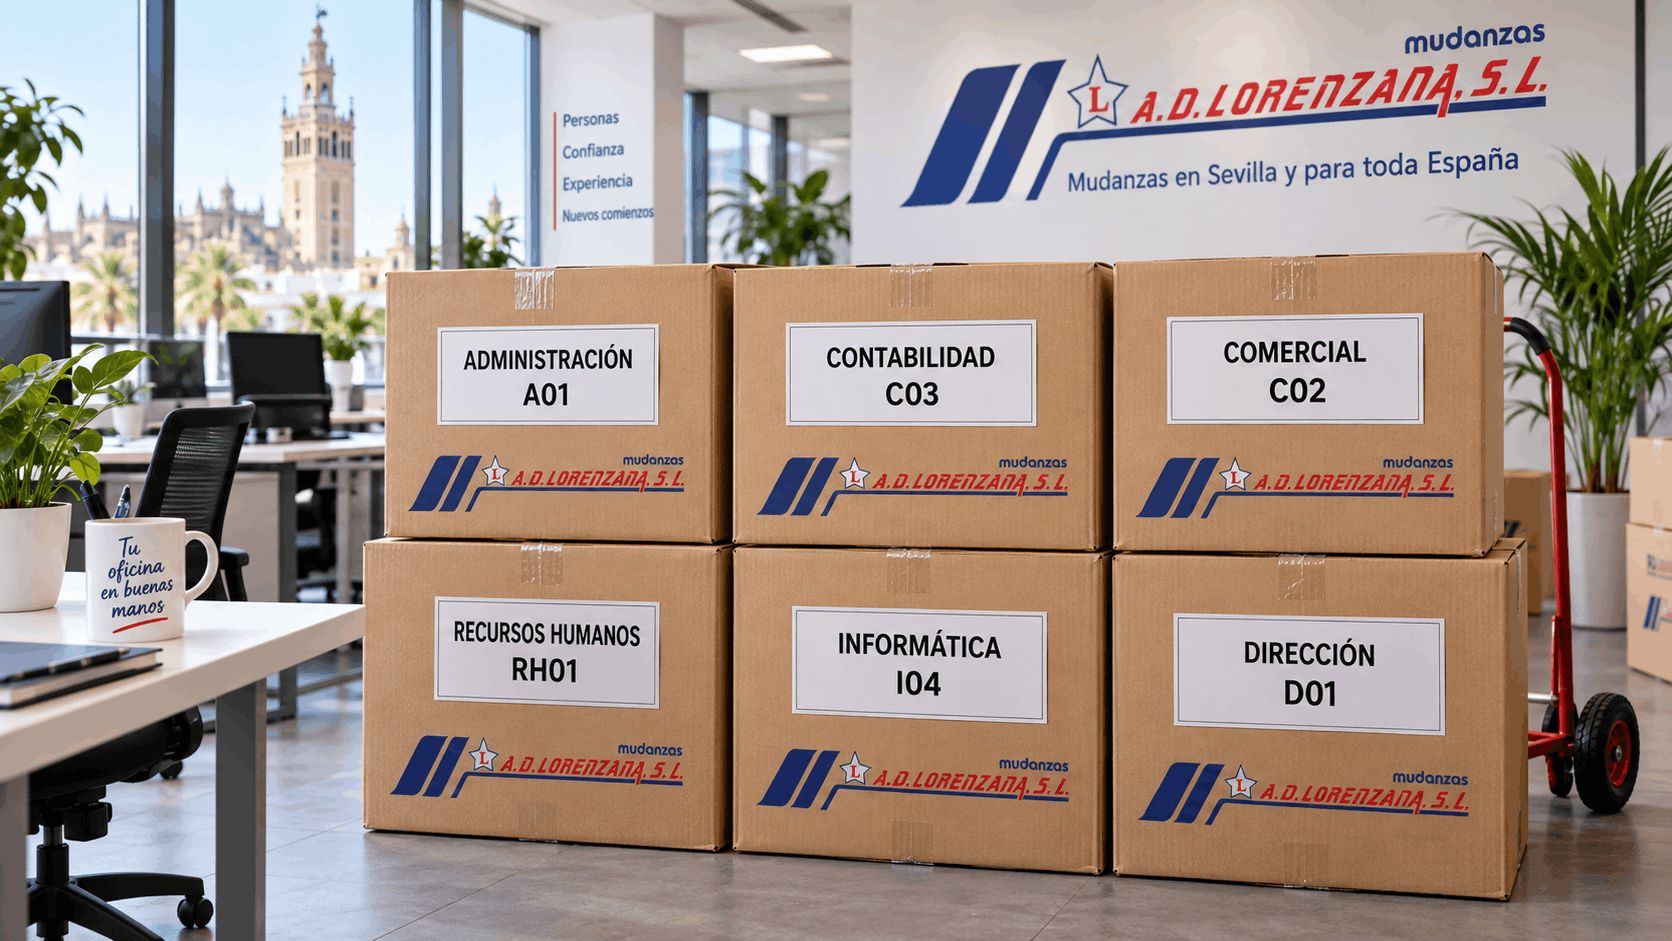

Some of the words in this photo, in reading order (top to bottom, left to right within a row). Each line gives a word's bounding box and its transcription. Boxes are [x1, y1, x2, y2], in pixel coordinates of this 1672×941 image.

[1404, 23, 1546, 55] mudanzas
[1088, 86, 1109, 113] L
[563, 113, 619, 127] Personas
[563, 143, 624, 159] Confianza
[1068, 171, 1168, 193] Mudanzas
[1175, 172, 1200, 187] en
[1208, 161, 1277, 185] Sevilla
[1285, 166, 1298, 187] y
[1305, 162, 1355, 186] para
[1362, 153, 1418, 177] toda
[1428, 147, 1519, 179] España
[563, 173, 633, 194] Experiencia
[562, 209, 599, 222] Nuevos
[601, 206, 654, 220] comienzos
[463, 343, 633, 370] ADMINISTRACIÓN
[826, 346, 995, 369] CONTABILIDAD
[1223, 340, 1367, 364] COMERCIAL
[522, 382, 568, 406] A01
[885, 381, 939, 406] C03
[1269, 377, 1326, 403] C02
[623, 454, 684, 466] mudanzas
[999, 456, 1068, 469] mudanzas
[1383, 456, 1454, 469] mudanzas
[492, 468, 501, 480] L
[850, 470, 861, 483] L
[1230, 471, 1242, 485] L
[118, 536, 141, 558] Tu
[108, 559, 165, 584] oficina
[101, 588, 119, 600] en
[124, 579, 174, 598] buenas
[111, 600, 165, 618] manos
[454, 620, 546, 645] RECURSOS
[551, 623, 641, 647] HUMANOS
[838, 629, 1002, 659] INFORMÁTICA
[1244, 637, 1375, 667] DIRECCIÓN
[512, 656, 577, 683] RH01
[1284, 679, 1336, 707] D01
[479, 751, 489, 765] L
[617, 742, 683, 757] mudanzas
[851, 764, 861, 779] L
[999, 757, 1069, 772] mudanzas
[1236, 778, 1247, 792] L
[1392, 770, 1469, 786] mudanzas
